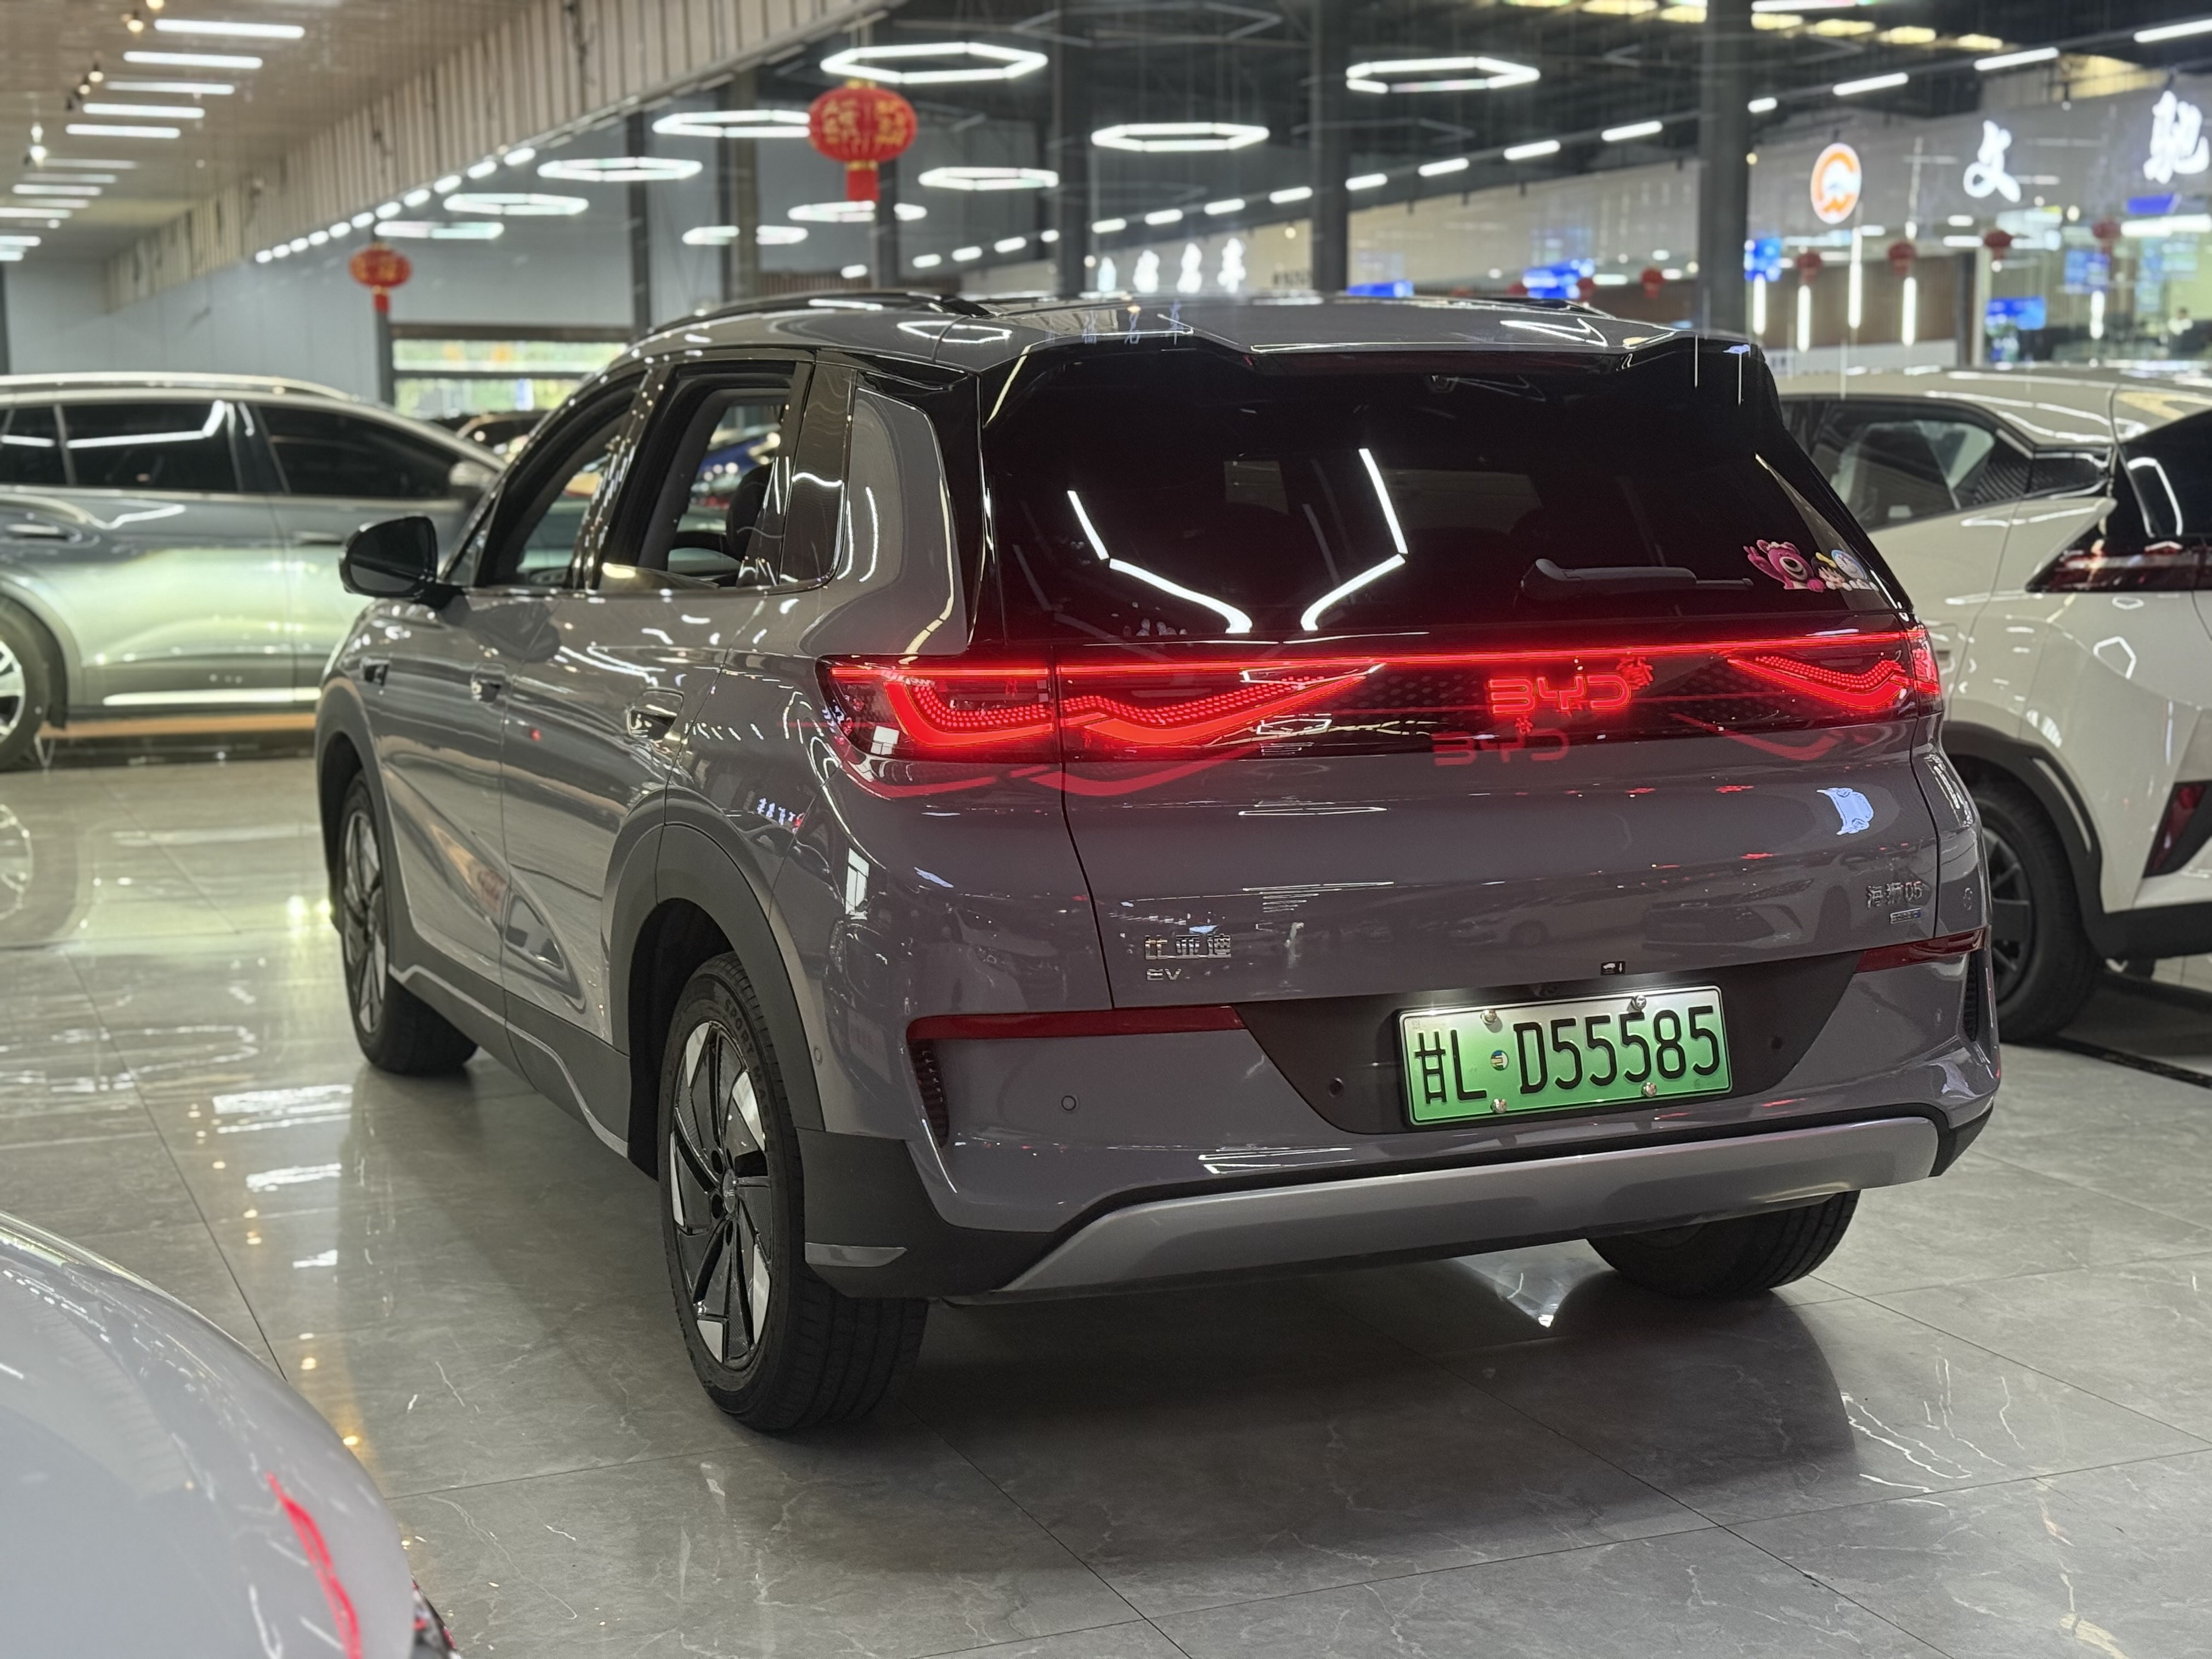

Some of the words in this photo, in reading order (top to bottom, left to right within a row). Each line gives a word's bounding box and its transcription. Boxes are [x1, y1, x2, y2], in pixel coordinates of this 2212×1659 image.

[1488, 674, 1632, 714] BYD
[1145, 933, 1232, 960] 比亚迪
[1147, 968, 1182, 981] EV
[1513, 1005, 1720, 1094] D55585
